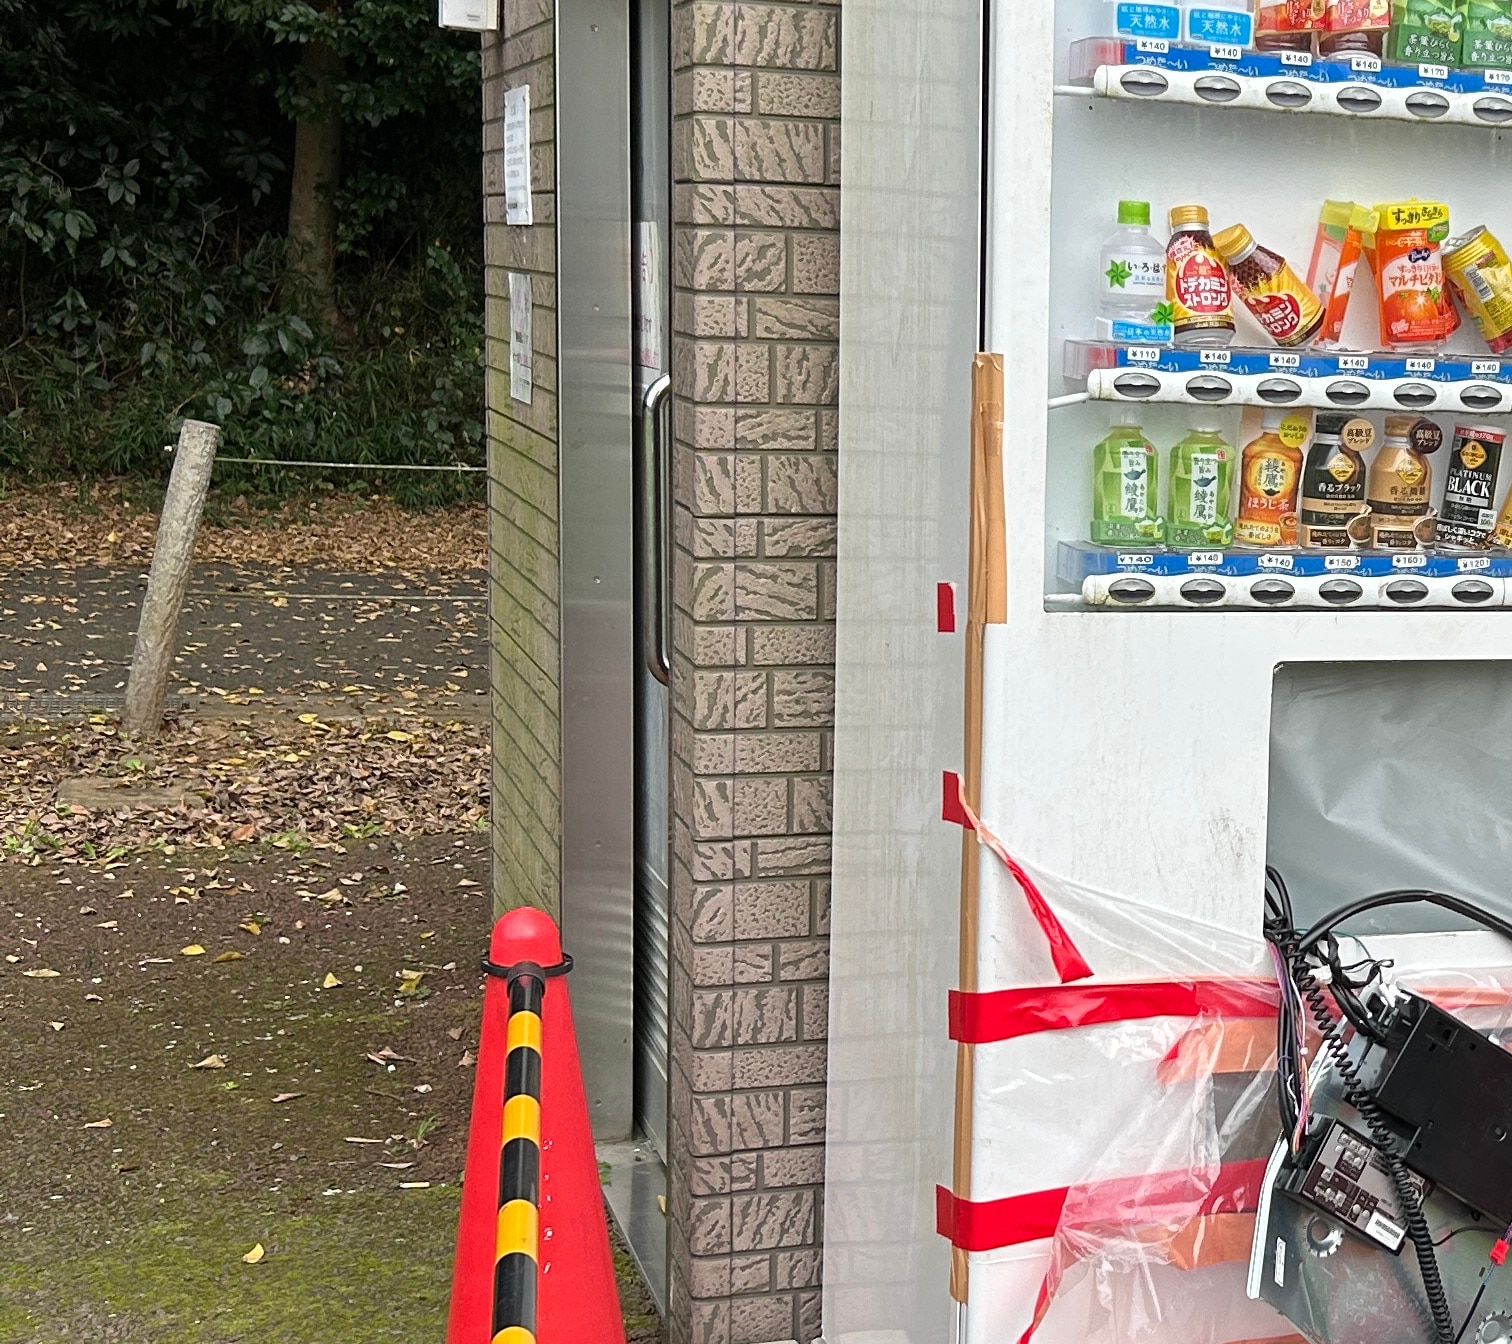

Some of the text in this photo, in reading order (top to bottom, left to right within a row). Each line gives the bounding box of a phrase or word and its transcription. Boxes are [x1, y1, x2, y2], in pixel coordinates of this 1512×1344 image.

[1129, 13, 1170, 30] 天然水
[1201, 19, 1242, 37] 天然水
[1141, 41, 1166, 51] ¥140
[1214, 47, 1238, 57] ¥140
[1404, 46, 1455, 63] 香り立つ旨み
[1285, 54, 1309, 63] ¥140
[1355, 60, 1378, 69] ¥140
[1423, 67, 1445, 76] ¥170
[1488, 73, 1511, 82] ¥170
[1391, 207, 1421, 225] すっきり
[1183, 292, 1228, 308] ストロング
[1131, 350, 1155, 359] ¥110
[1204, 352, 1228, 362] ¥140
[1273, 356, 1297, 366] ¥140
[1342, 358, 1366, 367] ¥140
[1410, 361, 1432, 369] ¥140
[1475, 363, 1497, 372] ¥140
[1347, 427, 1372, 439] 高級豆
[1415, 429, 1440, 440] 高級豆
[1347, 436, 1370, 445] ブレンド
[1449, 467, 1492, 482] PLATINUM
[1318, 482, 1361, 494] 香るブラック
[1447, 475, 1490, 498] BLACK
[1247, 496, 1290, 511] ほうじ茶
[1195, 554, 1219, 562] ¥140
[1267, 556, 1291, 566] ¥140
[1328, 558, 1352, 567] ¥150
[1395, 557, 1418, 565] ¥160
